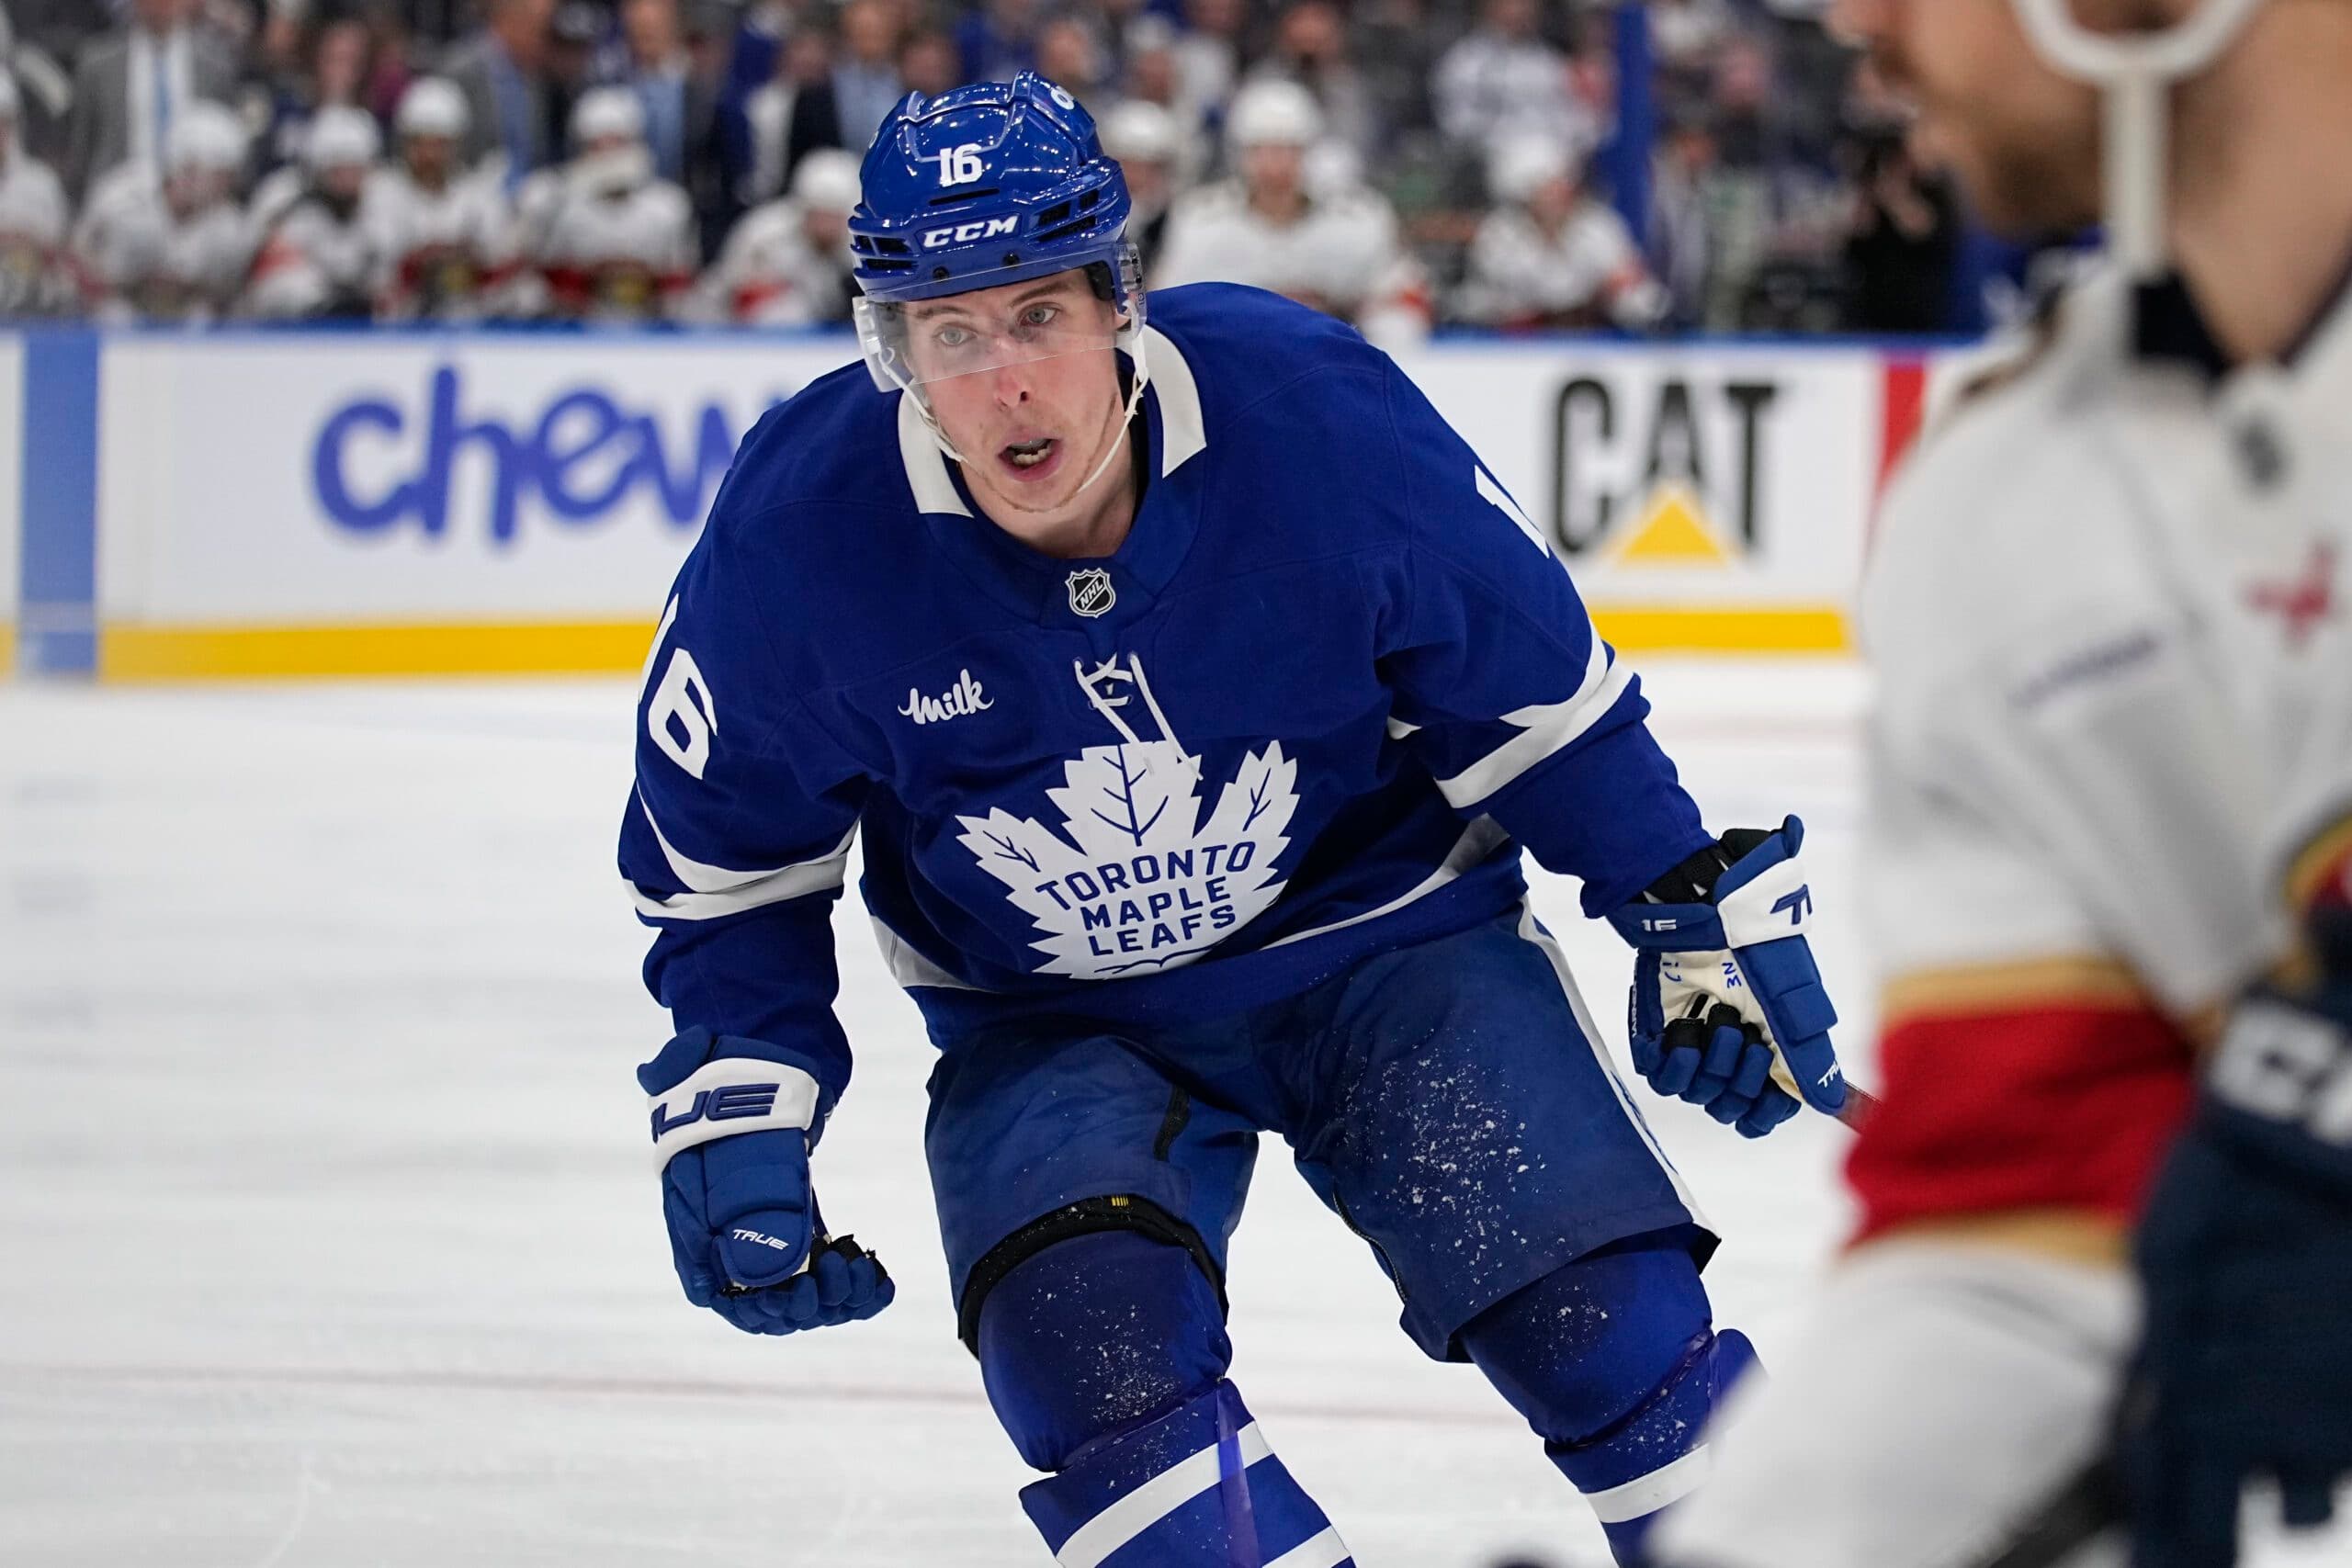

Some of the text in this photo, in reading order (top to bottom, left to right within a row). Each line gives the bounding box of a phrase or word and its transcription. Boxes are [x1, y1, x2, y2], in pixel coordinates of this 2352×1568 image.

[939, 142, 983, 187] 16
[923, 215, 1019, 248] CCM
[1553, 376, 1779, 557] CAT
[1080, 580, 1104, 609] NHL
[1035, 840, 1257, 911] TORONTO
[1080, 875, 1231, 931] MAPLE
[1088, 905, 1237, 956] LEAFS
[650, 1083, 781, 1145] UE
[732, 1228, 789, 1250] TRUE
